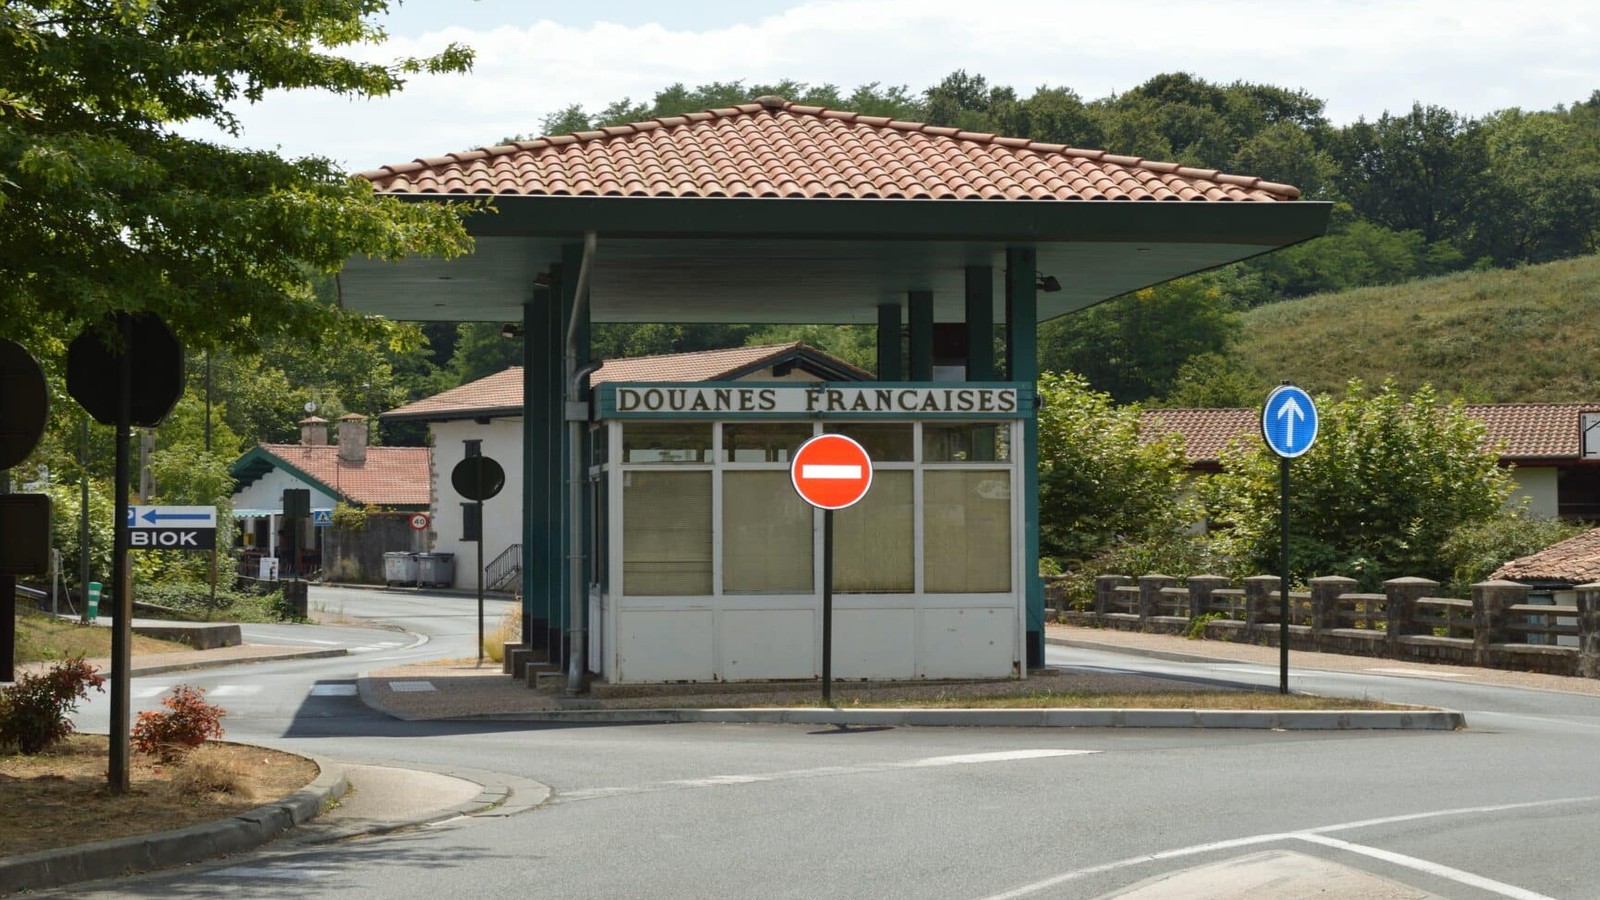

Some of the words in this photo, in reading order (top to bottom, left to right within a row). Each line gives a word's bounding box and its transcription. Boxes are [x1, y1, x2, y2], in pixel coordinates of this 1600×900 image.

[618, 389, 776, 411] DOUANES
[805, 389, 1016, 412] FRANCAISES
[131, 531, 198, 546] BIOK
